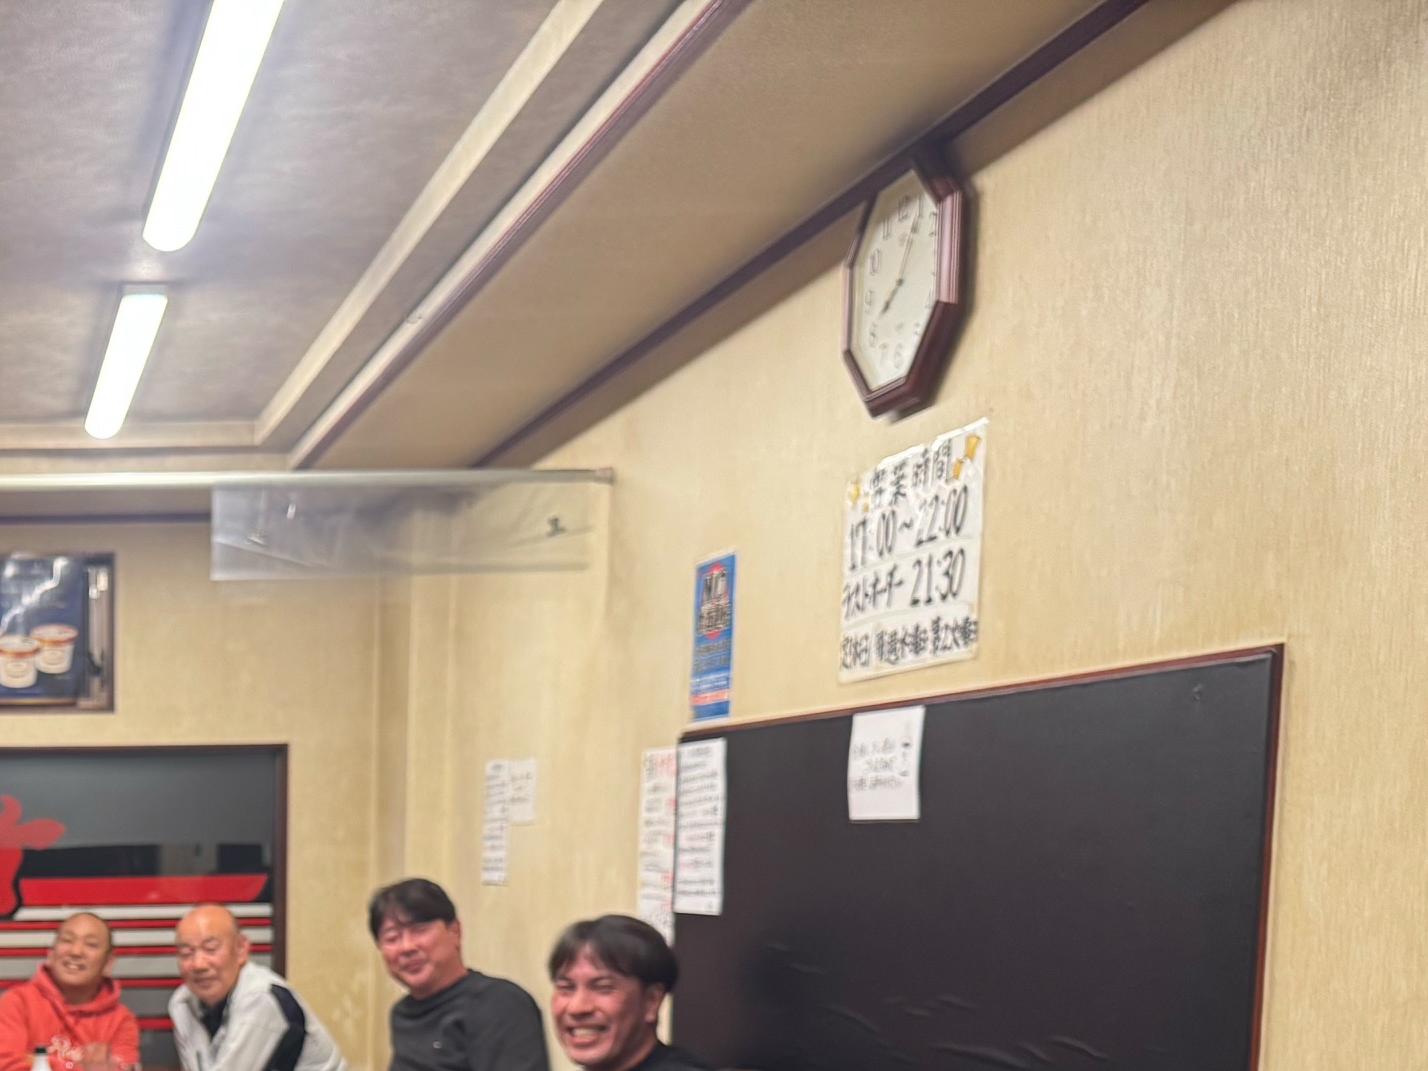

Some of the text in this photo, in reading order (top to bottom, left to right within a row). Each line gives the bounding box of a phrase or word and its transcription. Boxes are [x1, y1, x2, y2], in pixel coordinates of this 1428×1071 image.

[897, 195, 909, 222] 12
[869, 248, 882, 276] 10
[909, 548, 966, 608] 21:30
